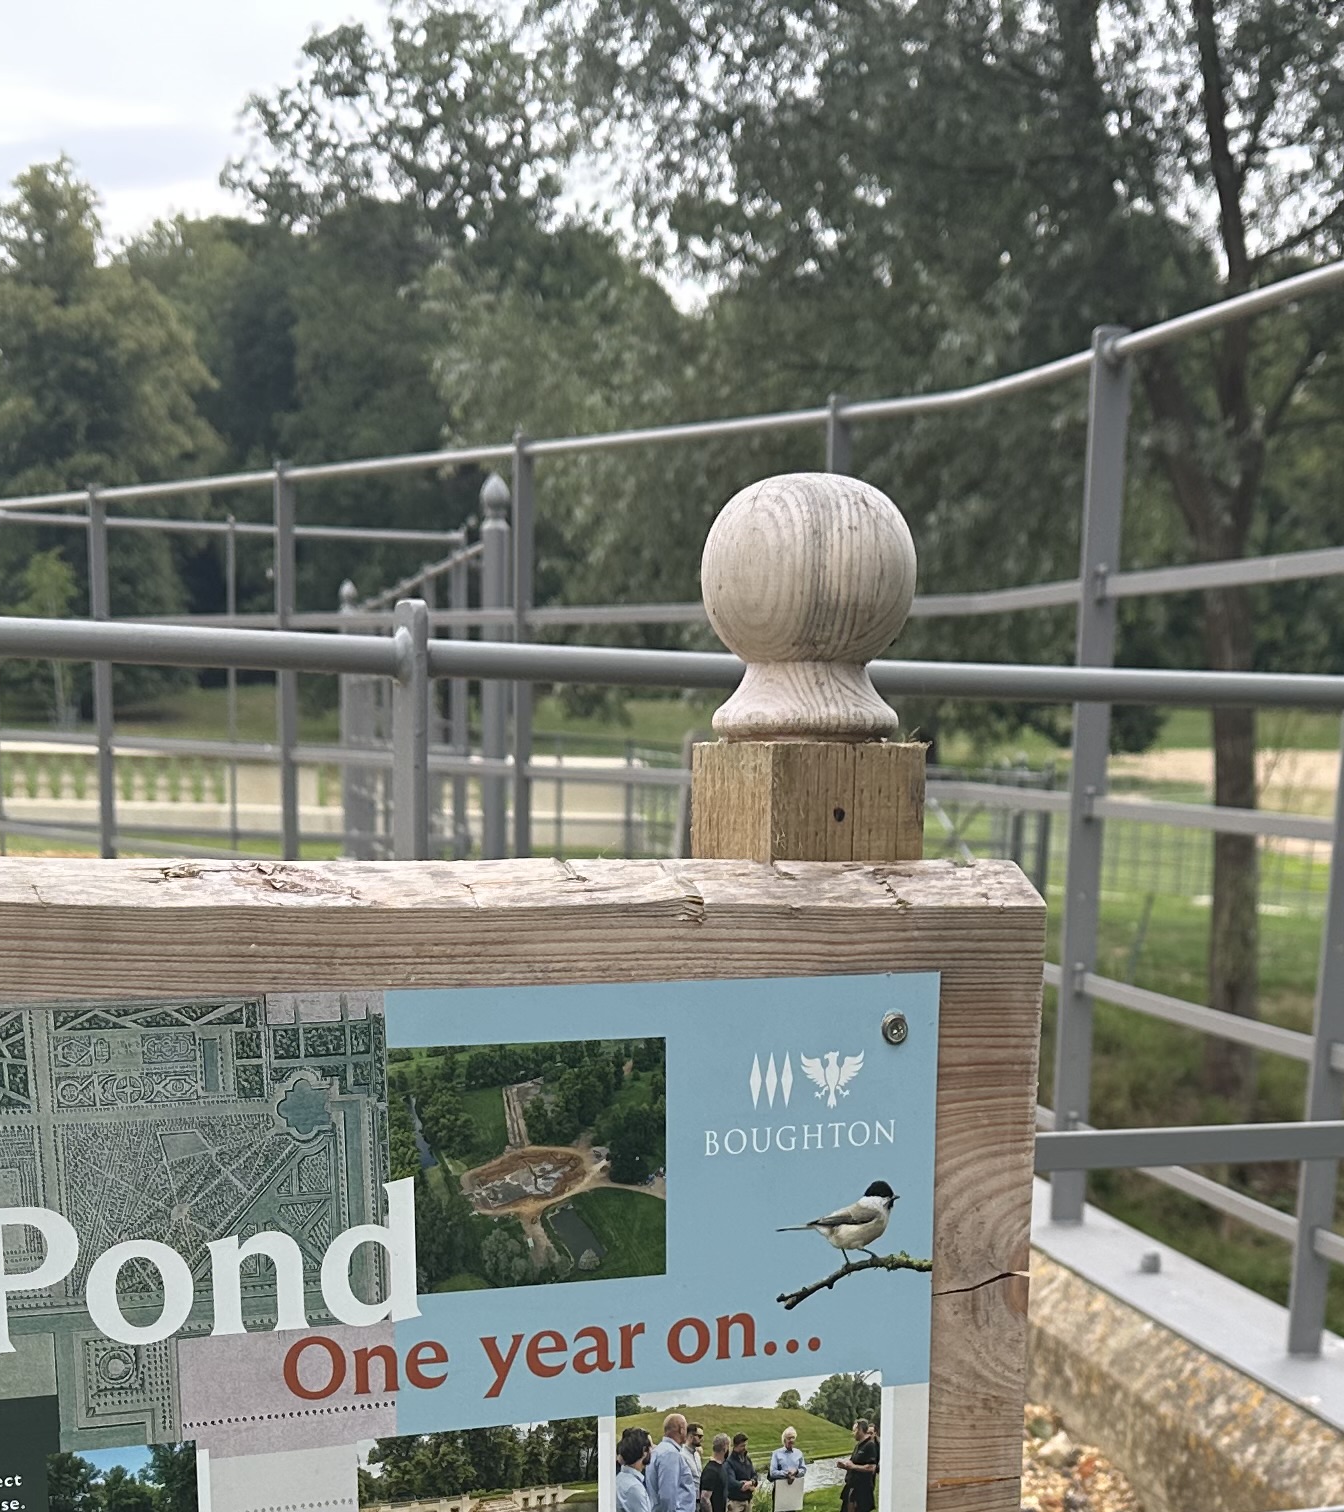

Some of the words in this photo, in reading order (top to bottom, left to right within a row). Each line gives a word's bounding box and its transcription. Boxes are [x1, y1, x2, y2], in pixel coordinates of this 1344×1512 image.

[704, 1118, 895, 1156] BOUGHTON
[282, 1335, 449, 1401] One
[479, 1322, 645, 1399] year
[666, 1311, 823, 1365] on...
